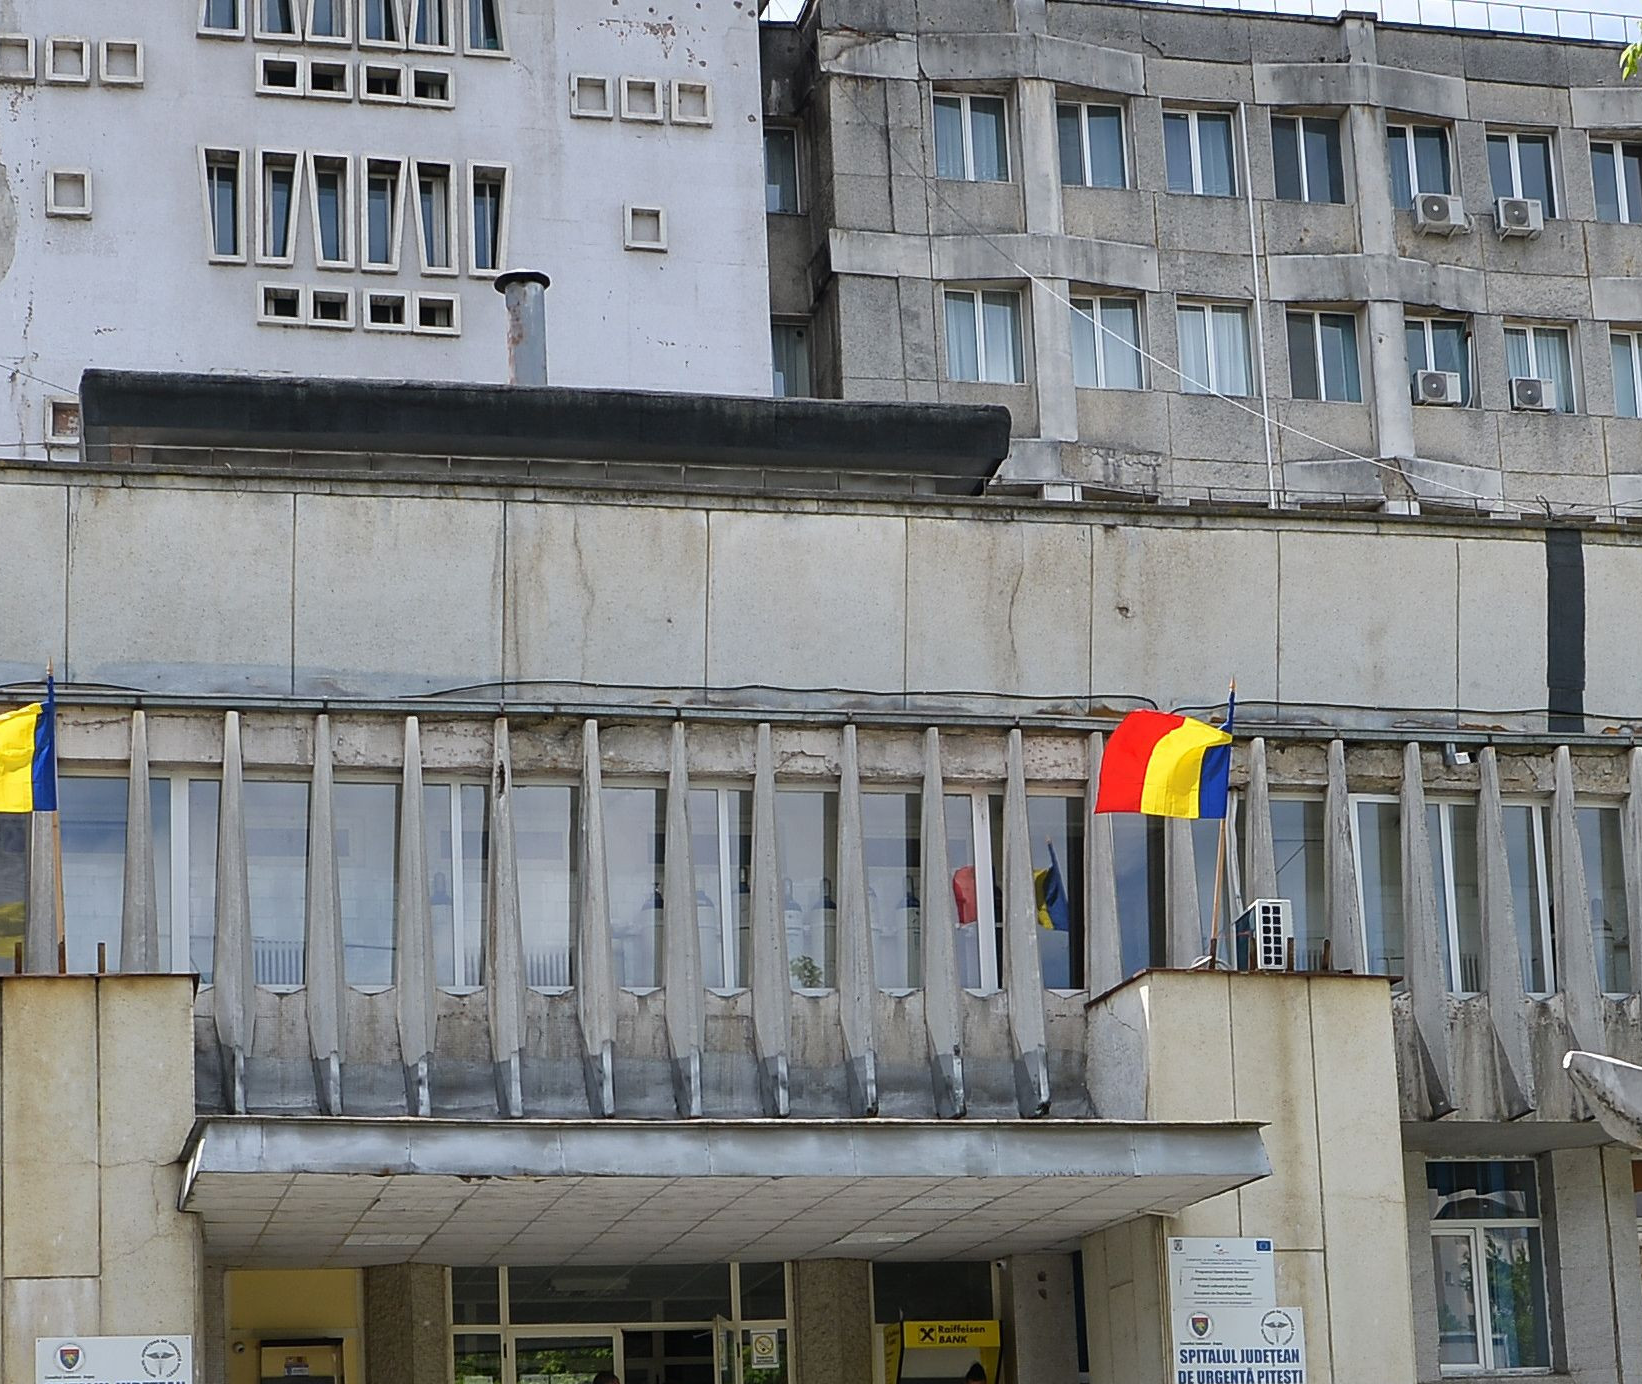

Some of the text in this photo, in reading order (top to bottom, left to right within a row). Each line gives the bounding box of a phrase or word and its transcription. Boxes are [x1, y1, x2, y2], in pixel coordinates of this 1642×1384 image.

[938, 1324, 986, 1334] Raiffeisen
[938, 1335, 967, 1344] BANK
[1179, 1350, 1238, 1365] SPITALUL
